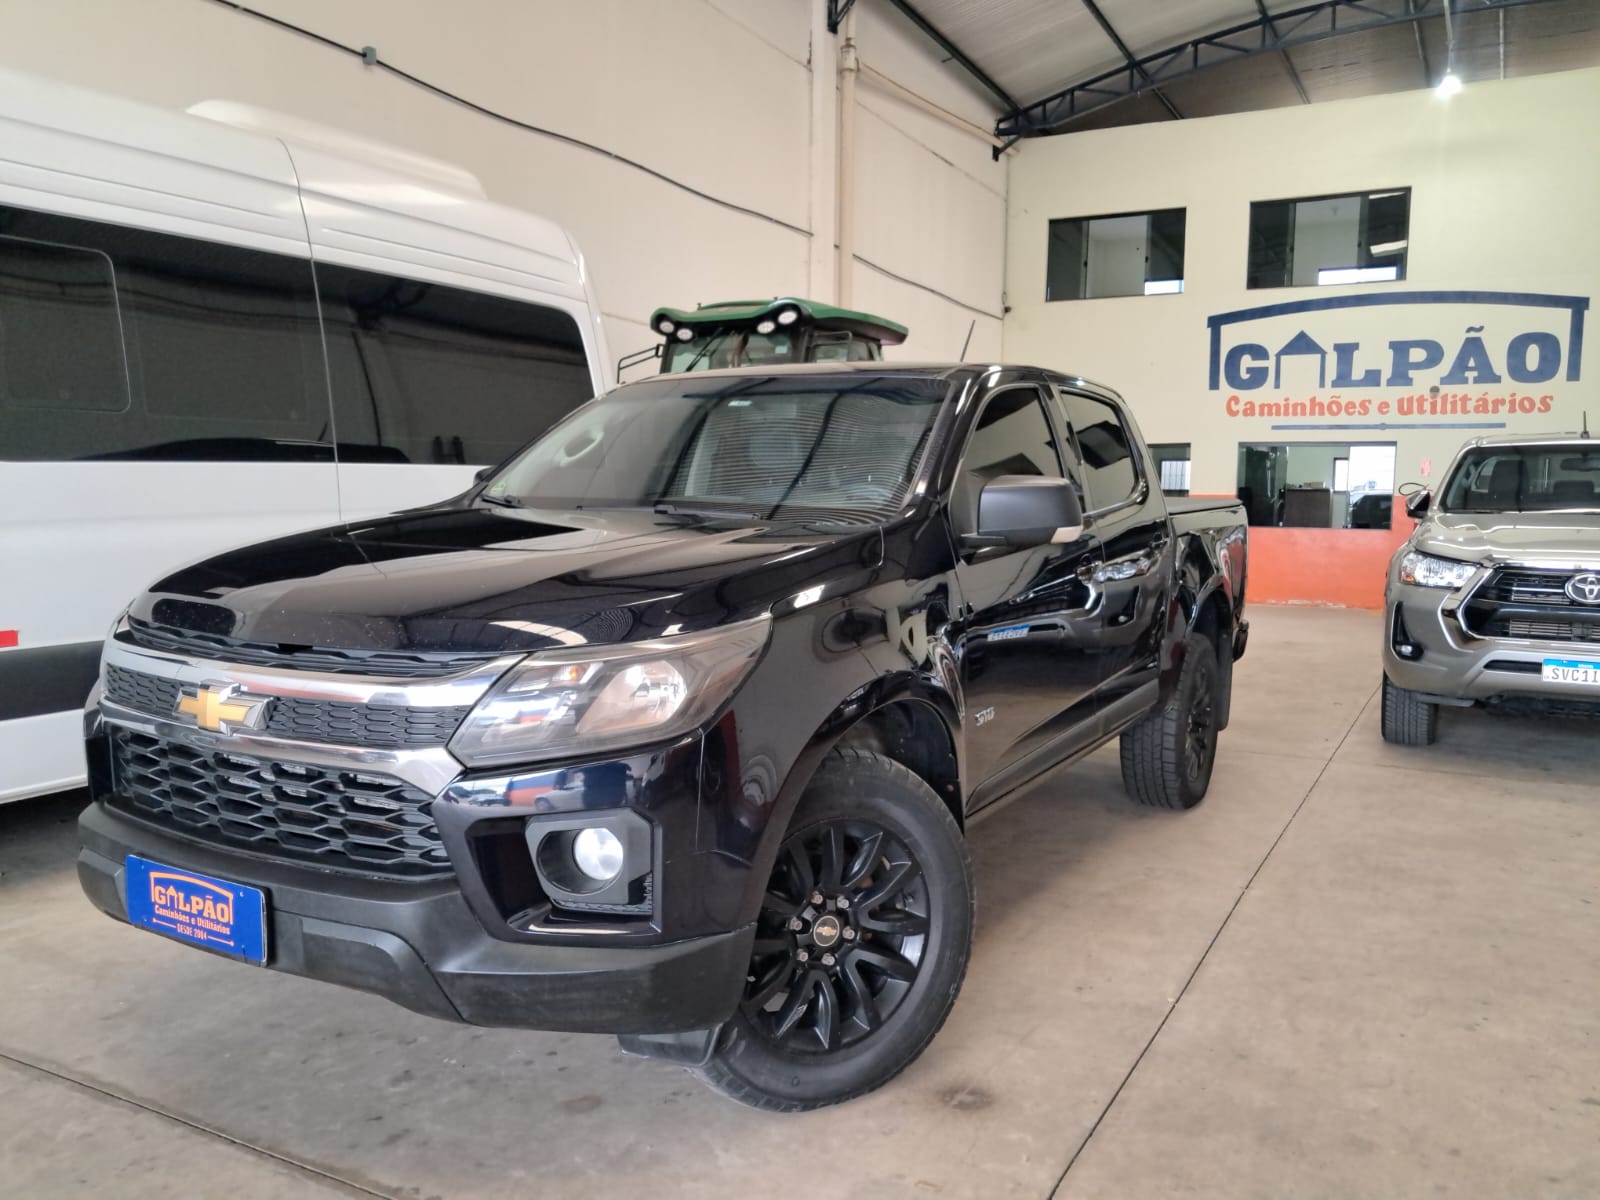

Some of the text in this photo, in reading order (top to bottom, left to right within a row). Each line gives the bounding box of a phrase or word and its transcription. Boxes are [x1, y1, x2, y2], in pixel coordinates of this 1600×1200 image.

[1225, 395, 1371, 418] Caminhões
[1377, 400, 1391, 415] e
[155, 905, 190, 923] Caminhões
[197, 918, 230, 935] Utilitários
[176, 923, 193, 935] DESDE
